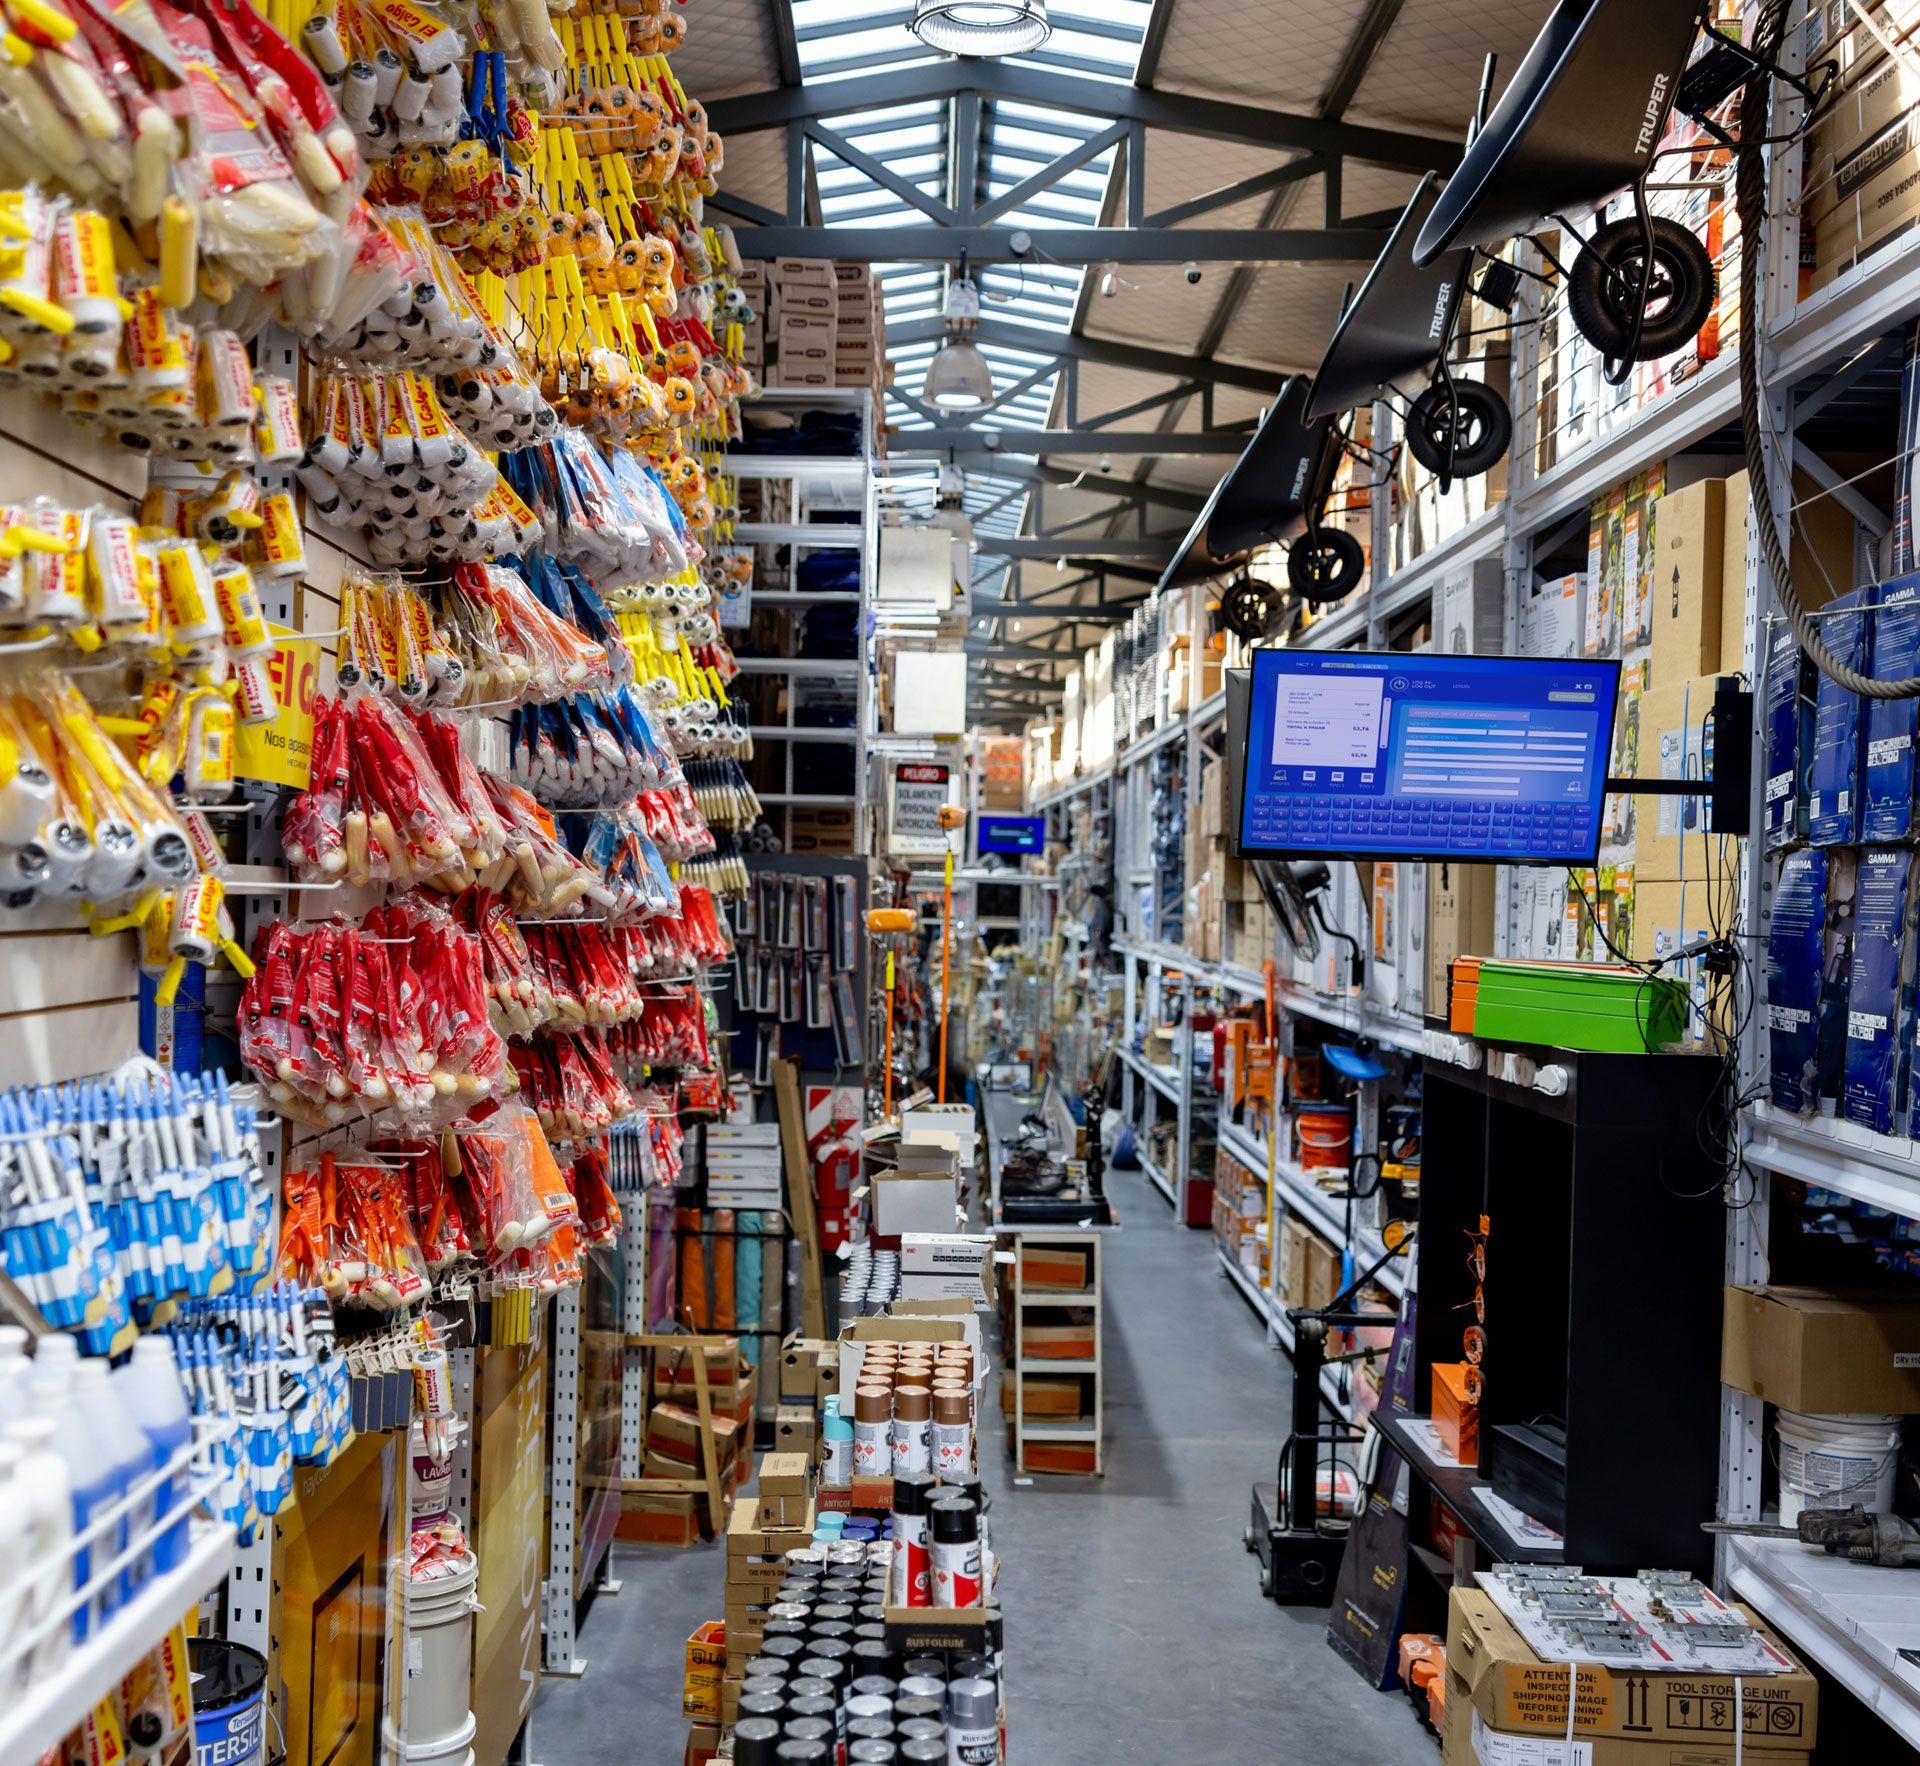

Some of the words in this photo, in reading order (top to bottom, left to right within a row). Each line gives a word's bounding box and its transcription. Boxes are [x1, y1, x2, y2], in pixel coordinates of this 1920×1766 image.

[385, 3, 418, 29] Galgo
[419, 19, 441, 38] El
[1634, 72, 1670, 155] TRUPER
[1429, 281, 1451, 339] TRUPER
[423, 425, 440, 437] El
[1290, 456, 1310, 502] TRUPER
[1885, 587, 1916, 605] GAMMA
[263, 729, 286, 749] Nos
[903, 767, 939, 780] PELIGRO
[897, 788, 943, 800] SOLAMENTE
[1786, 860, 1812, 871] GAMMA
[1868, 853, 1897, 866] GAMMA
[1895, 1356, 1909, 1364] DRV
[748, 1569, 759, 1577] THE
[1524, 1670, 1598, 1683] ATTENTON:
[1527, 1683, 1570, 1692] INSPECT
[1665, 1682, 1698, 1694] TOOL
[1701, 1684, 1760, 1698] STORGE
[1763, 1689, 1791, 1700] UNIT
[1513, 1691, 1563, 1702] SHIPPING
[1564, 1695, 1609, 1706] DMAGE
[1517, 1702, 1559, 1713] BEFORE
[1523, 1713, 1544, 1722] FOR
